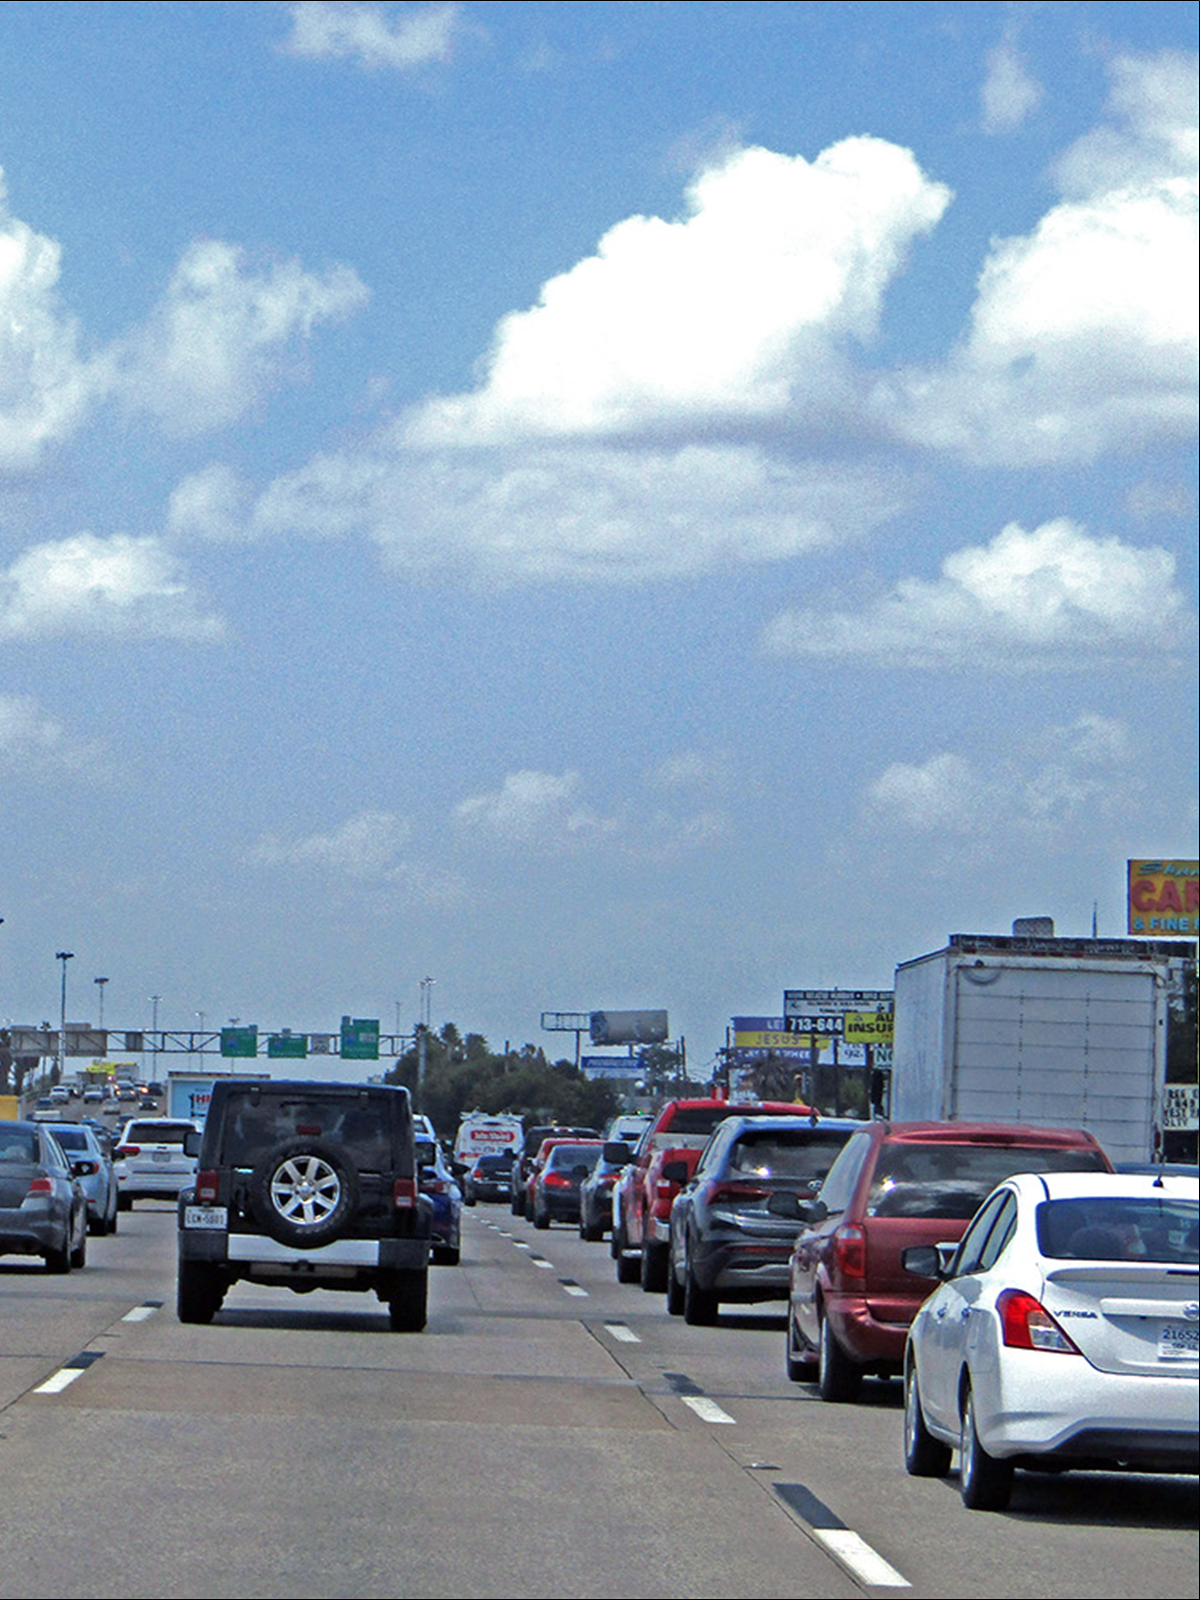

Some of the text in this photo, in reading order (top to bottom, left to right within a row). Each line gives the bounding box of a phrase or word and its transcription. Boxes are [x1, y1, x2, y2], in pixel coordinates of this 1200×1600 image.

[1150, 917, 1189, 931] FINE
[755, 1033, 799, 1045] JESUS
[1053, 1310, 1098, 1319] VERSA
